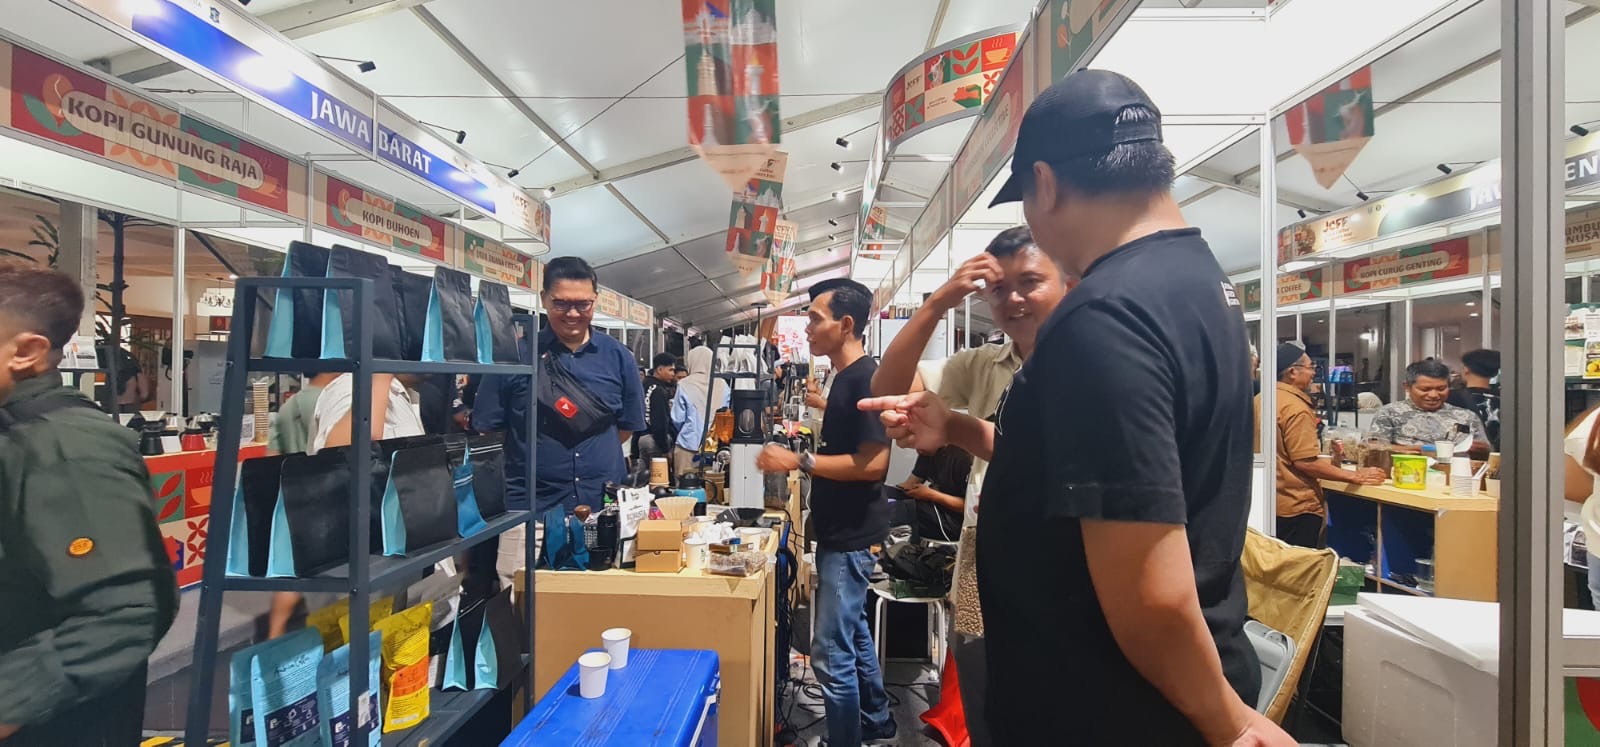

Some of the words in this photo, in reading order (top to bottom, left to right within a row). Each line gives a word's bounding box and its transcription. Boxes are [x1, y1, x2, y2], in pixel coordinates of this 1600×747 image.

[67, 97, 124, 132] KOPI
[131, 122, 215, 165] GUNUNG
[220, 156, 258, 181] RAJA
[310, 90, 371, 145] JAWA
[377, 129, 432, 175] BARAT
[362, 210, 384, 227] KOPI
[386, 219, 420, 239] BUHOEN
[1379, 265, 1404, 276] CURUG
[1405, 258, 1442, 271] GENTING
[1280, 283, 1302, 294] COFFEE
